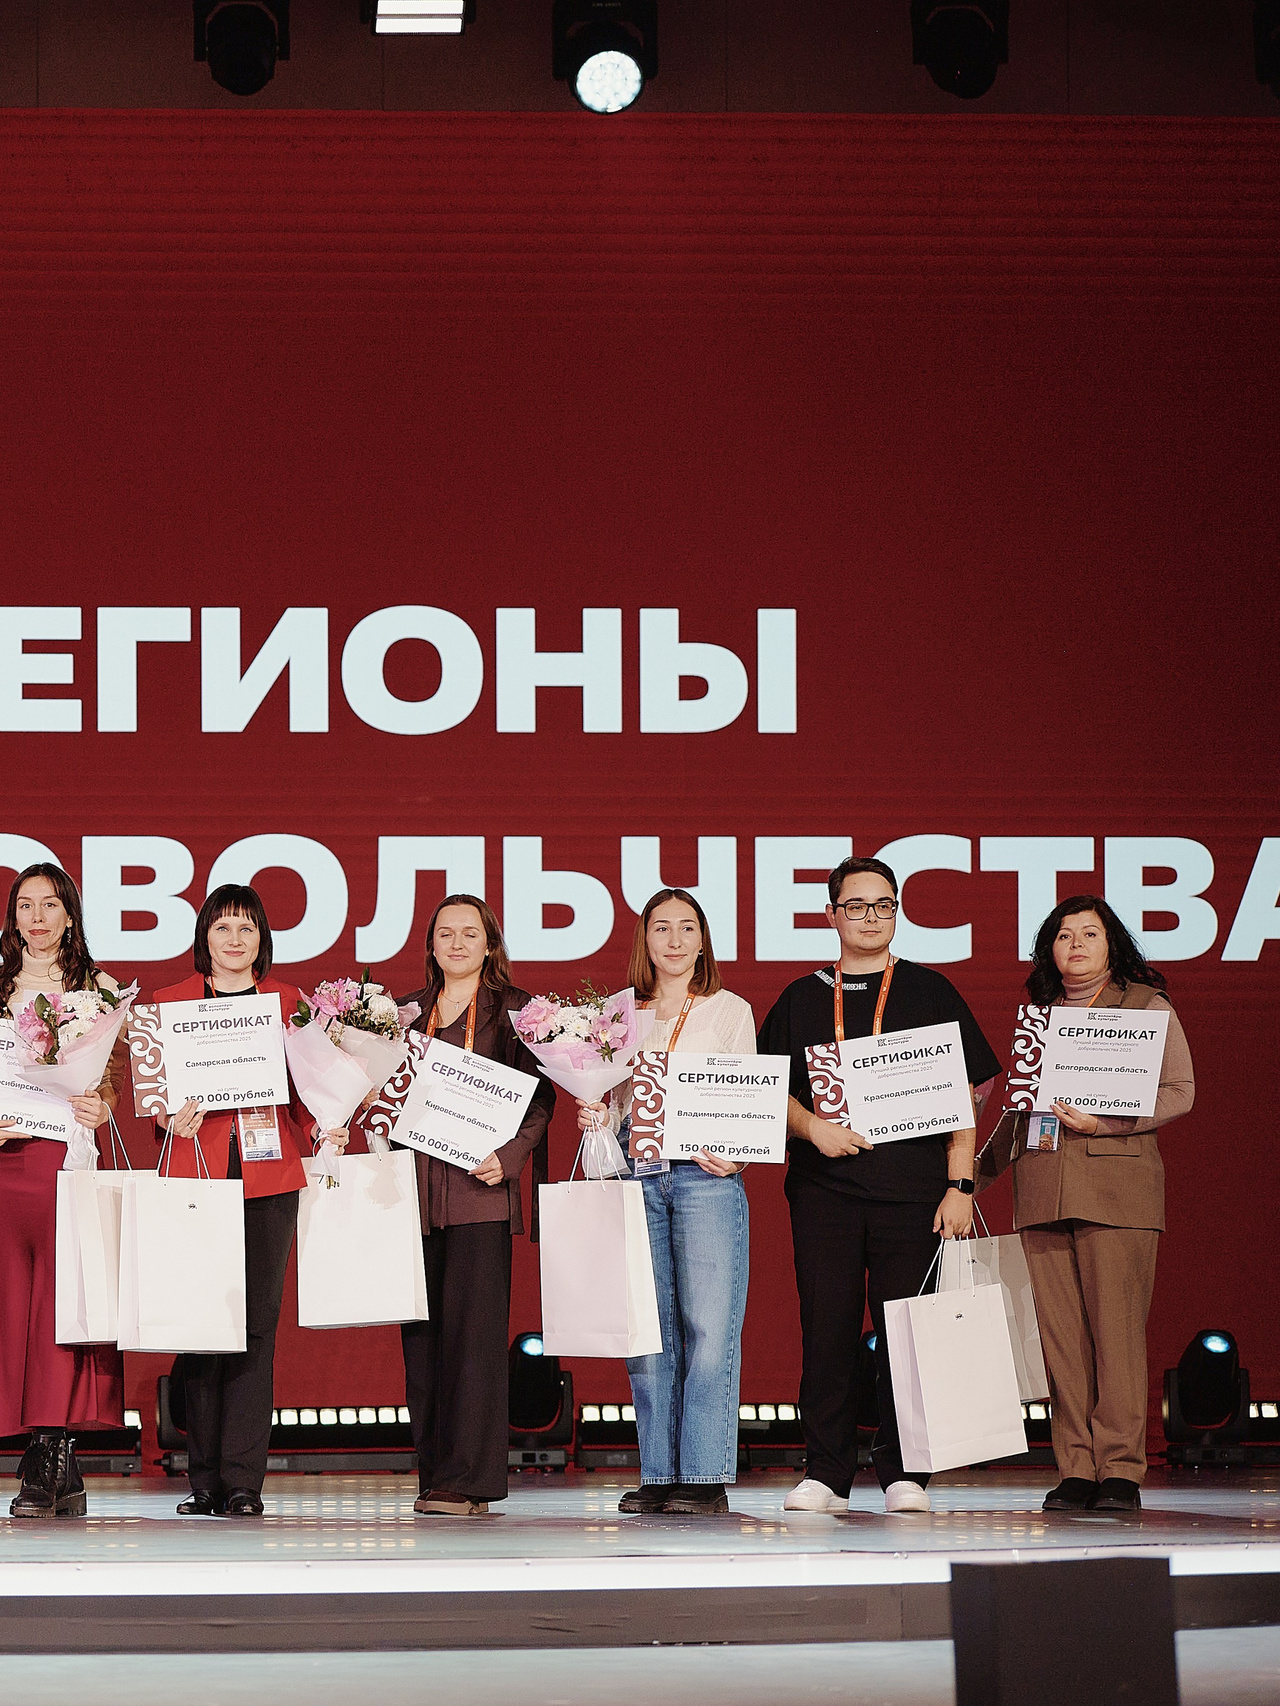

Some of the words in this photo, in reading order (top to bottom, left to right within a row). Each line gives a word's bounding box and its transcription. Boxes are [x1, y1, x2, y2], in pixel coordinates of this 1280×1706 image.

[172, 1015, 272, 1033] СЕРТИФИКАТ
[1058, 1027, 1157, 1040] СЕРТИФИКАТ
[185, 1059, 231, 1068] Самарская
[232, 1056, 266, 1064] область
[852, 1043, 952, 1069] СЕРТИФИКАТ
[1055, 1063, 1113, 1072] Белгородская
[1114, 1066, 1148, 1074] область
[431, 1062, 522, 1103] СЕРТИФИКАТ
[678, 1073, 779, 1086] СЕРТИФИКАТ
[207, 1093, 230, 1102] 000
[233, 1088, 274, 1102] рублей
[863, 1085, 930, 1103] Краснодарский
[932, 1081, 953, 1091] край
[1075, 1097, 1097, 1106] 000
[1099, 1099, 1140, 1109] рублей
[425, 1099, 466, 1120] Кировская
[466, 1117, 497, 1133] область
[677, 1110, 739, 1119] Владимирская
[741, 1112, 776, 1120] область
[25, 1118, 66, 1133] рублей
[868, 1126, 888, 1136] 150
[891, 1122, 914, 1133] 000
[917, 1114, 959, 1131] рублей
[408, 1130, 425, 1143] 150
[427, 1138, 448, 1152] 000
[449, 1149, 484, 1165] рубле
[679, 1144, 699, 1152] 150
[728, 1145, 770, 1156] рублей
